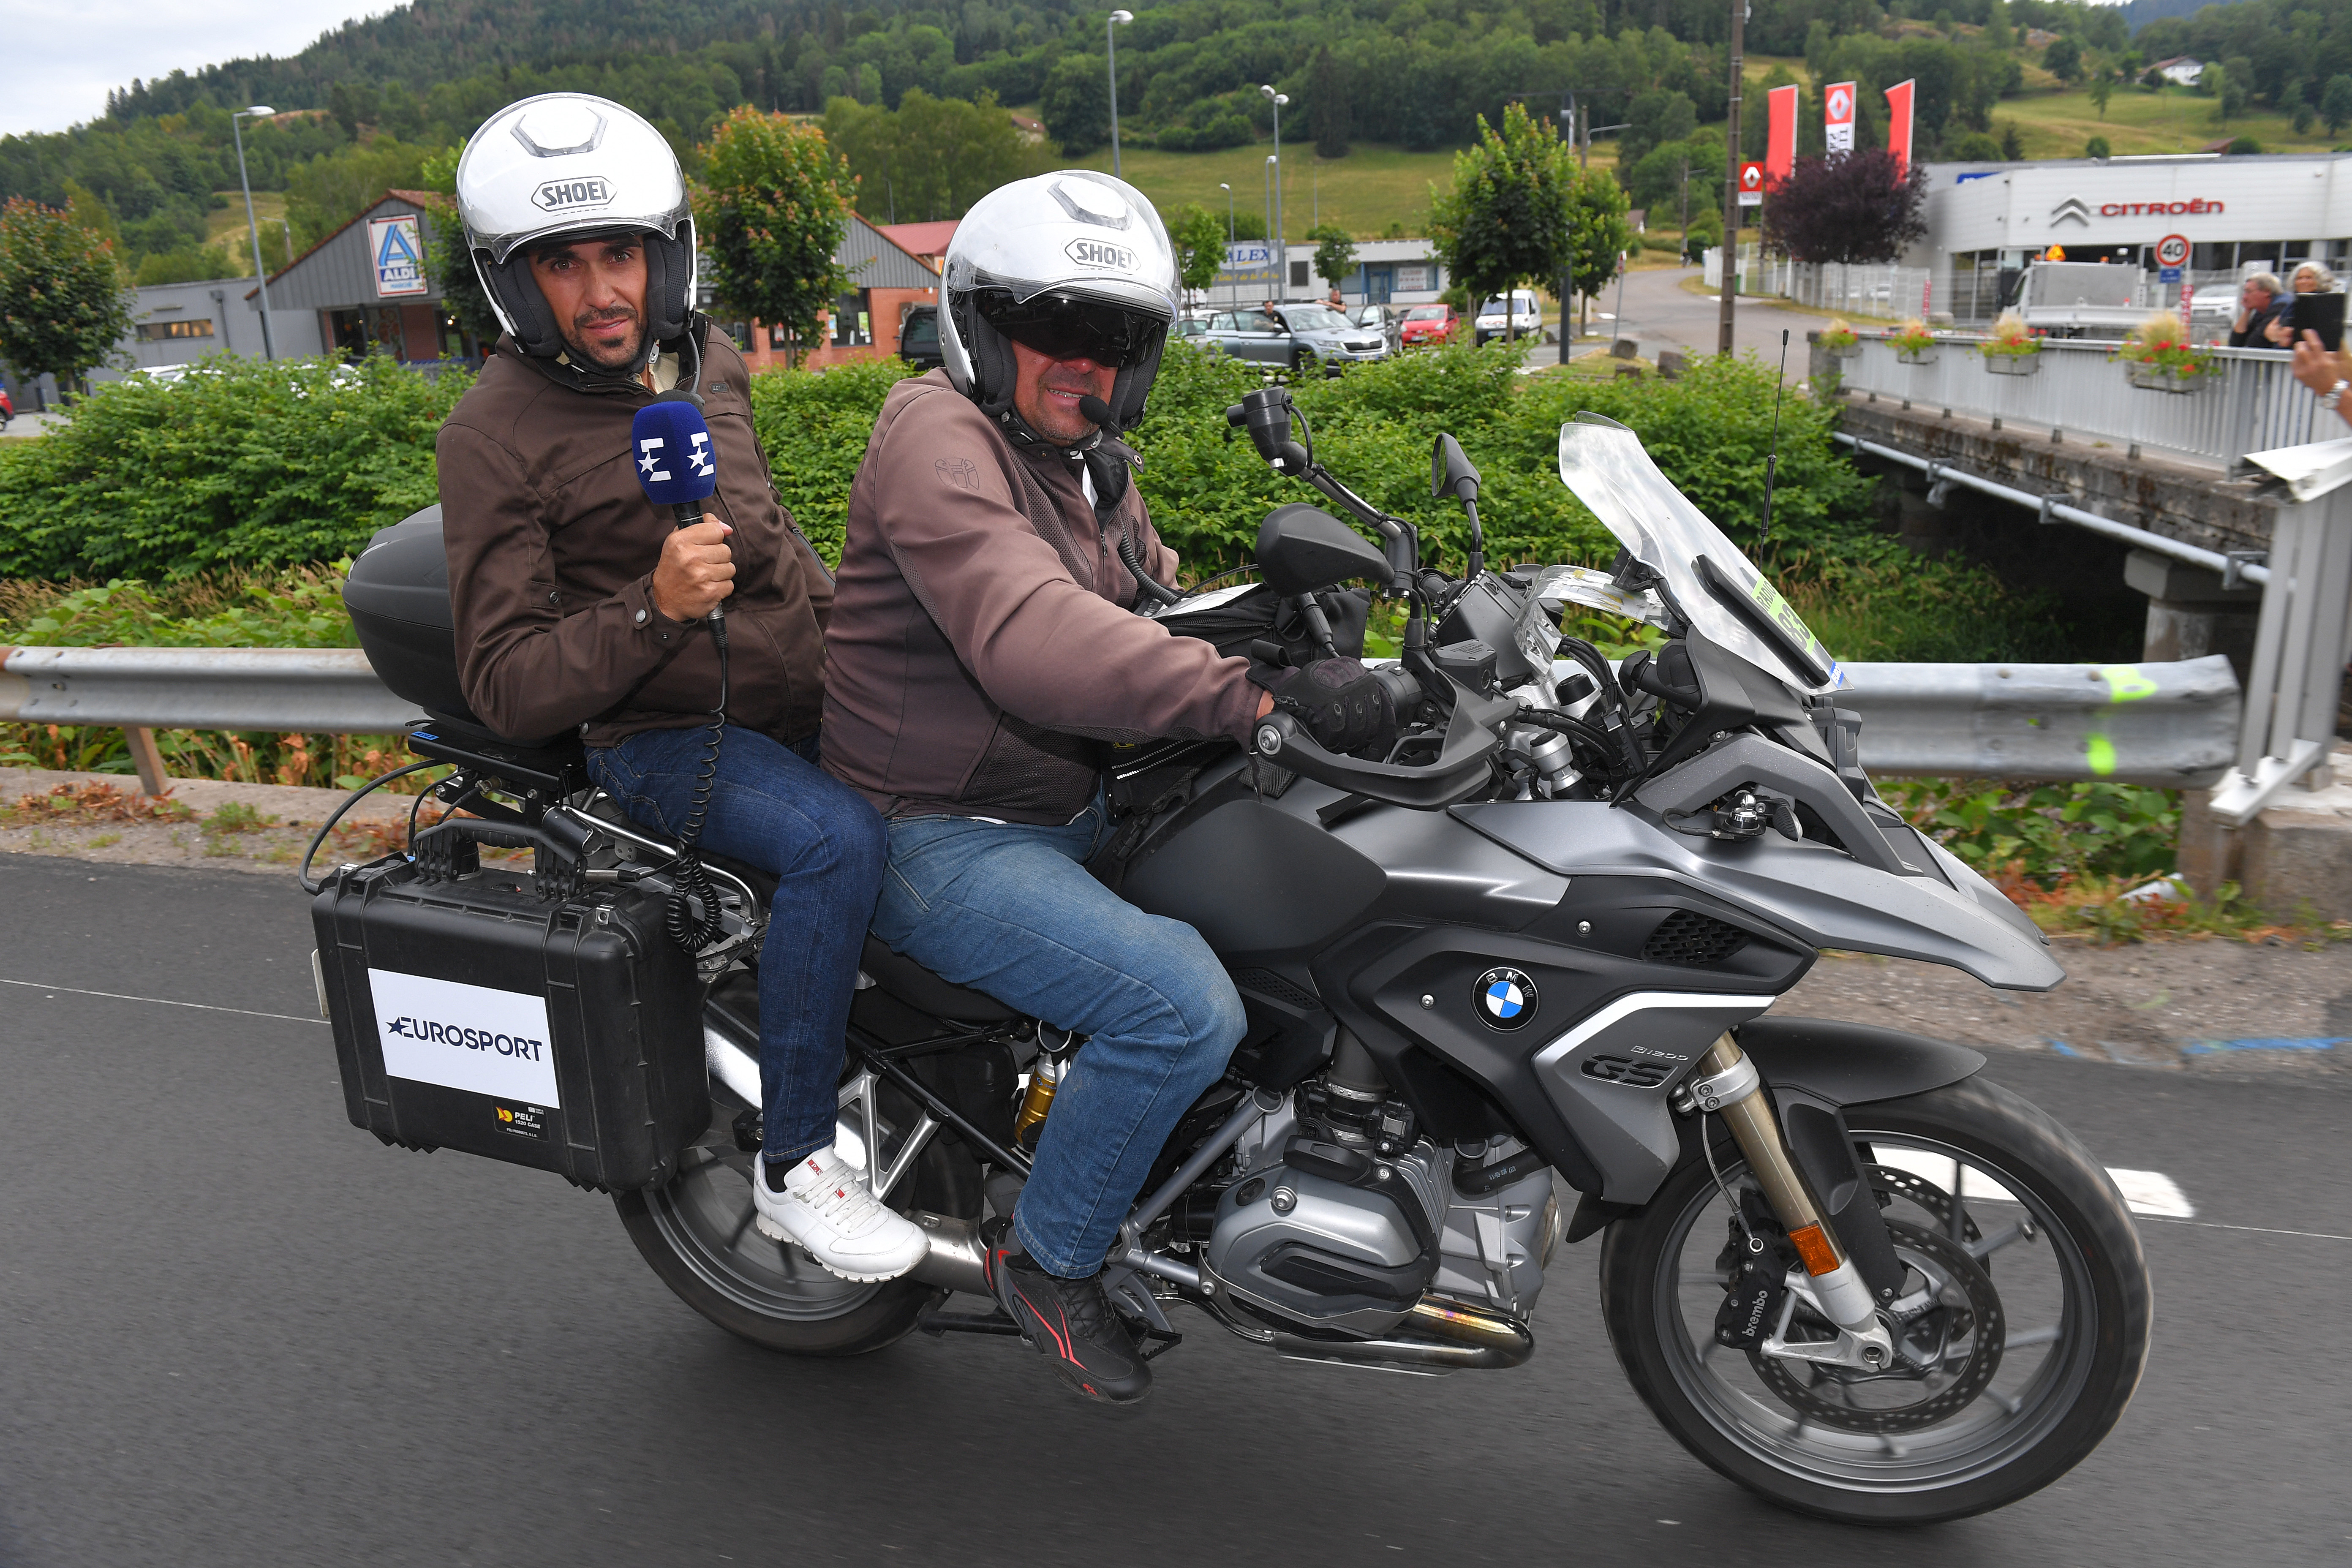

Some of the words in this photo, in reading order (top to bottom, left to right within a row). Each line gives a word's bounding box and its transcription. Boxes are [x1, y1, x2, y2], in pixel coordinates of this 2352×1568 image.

[542, 181, 607, 207] SHOEI
[1076, 242, 1132, 270] SHOEI
[2163, 243, 2184, 256] 40
[383, 267, 416, 281] ALDI
[1756, 580, 1776, 612] RADIO
[1778, 603, 1810, 649] 83
[1831, 662, 1842, 685] EURO
[1486, 971, 1535, 998] BMW
[385, 1016, 542, 1062] EUROSPORT
[1581, 1054, 1674, 1088] GS
[1742, 1290, 1768, 1337] brembo
